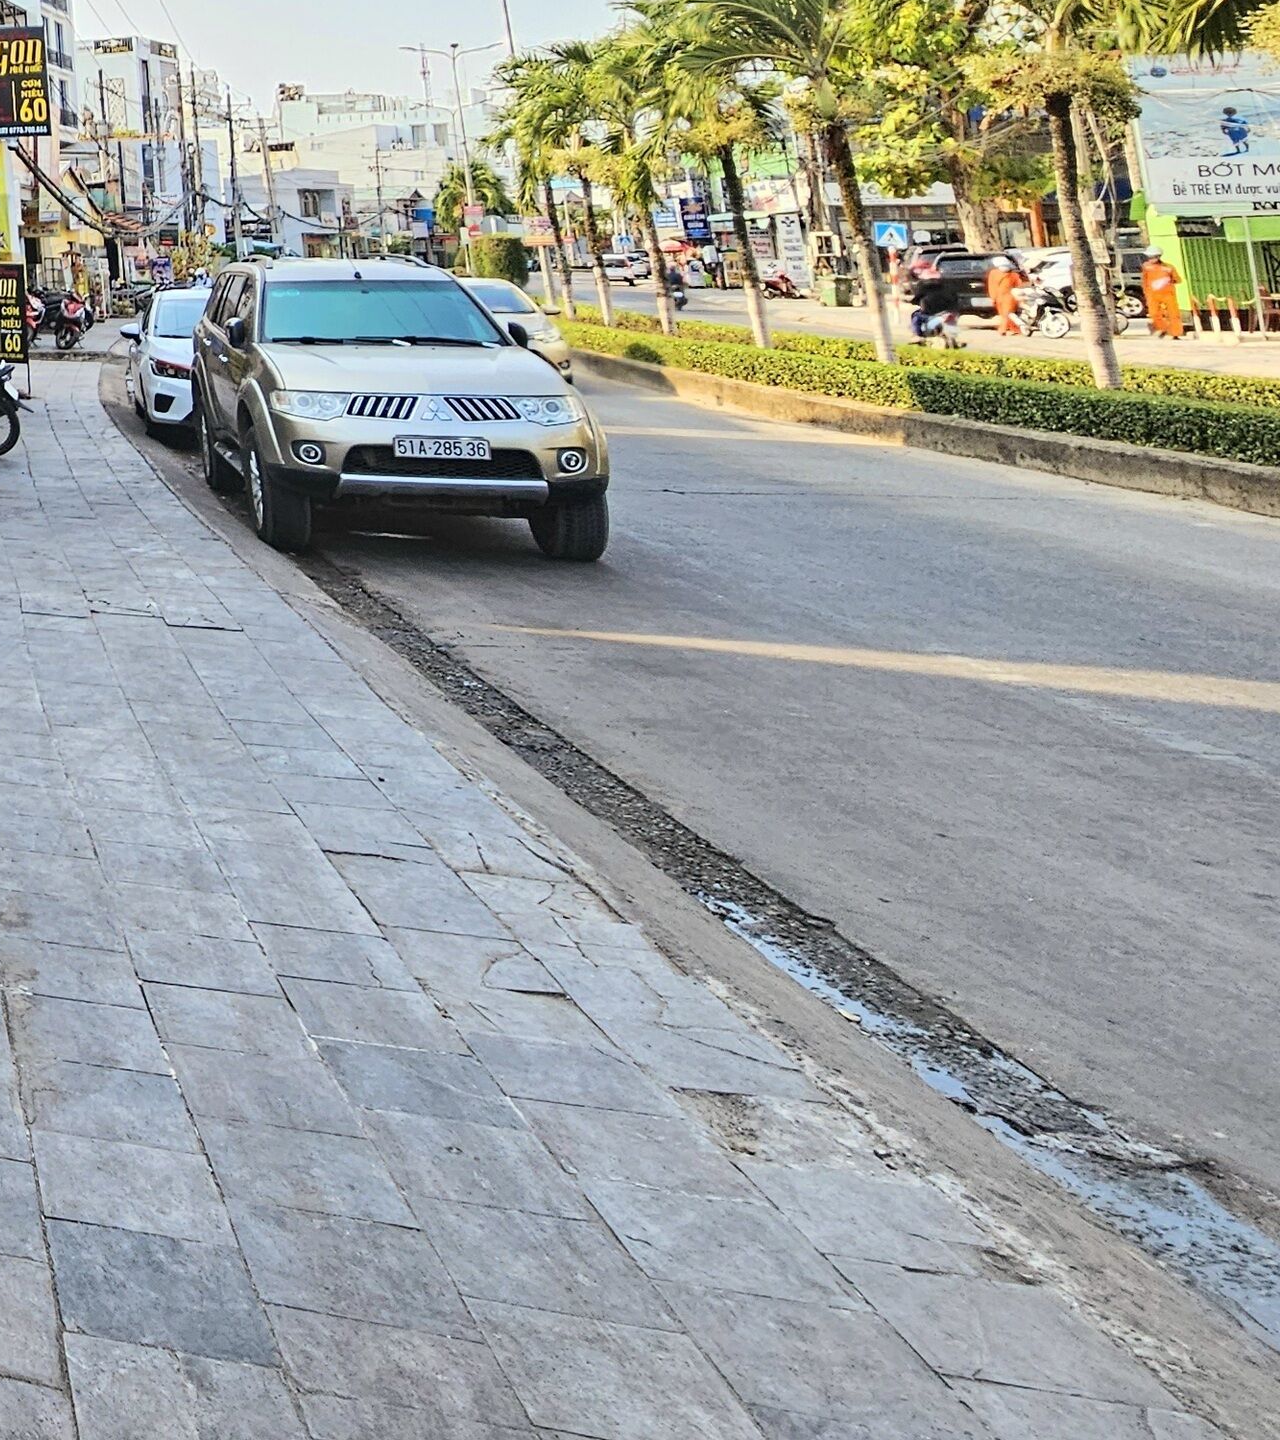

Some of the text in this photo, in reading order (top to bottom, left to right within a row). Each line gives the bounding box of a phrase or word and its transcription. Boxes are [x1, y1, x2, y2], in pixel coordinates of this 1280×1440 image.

[20, 98, 47, 122] 60
[1214, 183, 1232, 194] EM
[5, 333, 21, 352] 60
